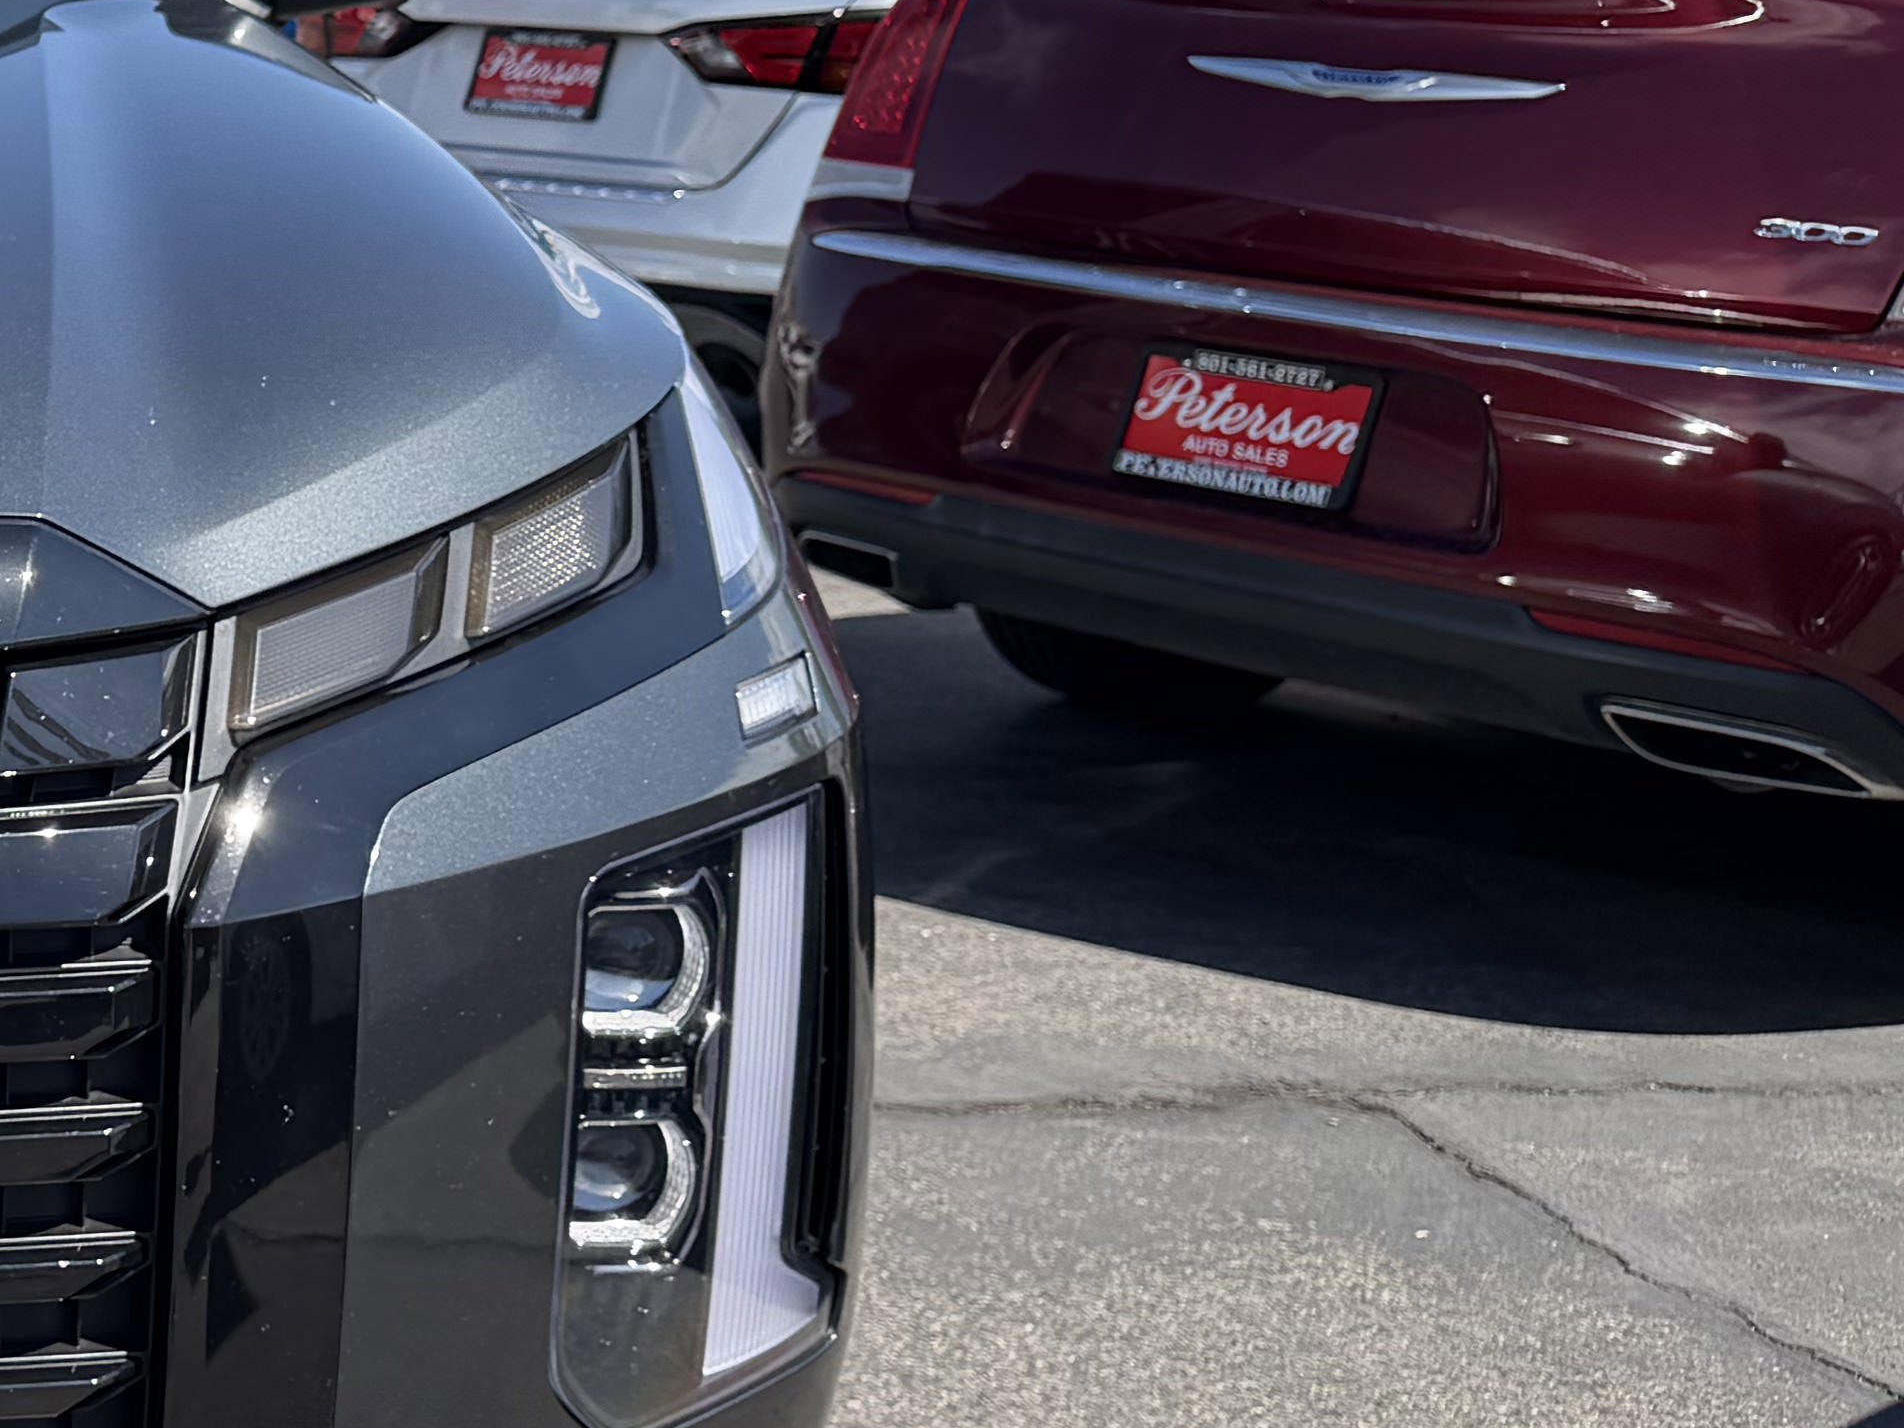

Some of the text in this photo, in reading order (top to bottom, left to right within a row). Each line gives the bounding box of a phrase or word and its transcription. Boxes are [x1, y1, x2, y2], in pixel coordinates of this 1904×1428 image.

[1753, 217, 1880, 247] 300
[1134, 367, 1359, 455] Peterson
[1182, 434, 1227, 457] AUTO
[1232, 442, 1290, 468] SALES
